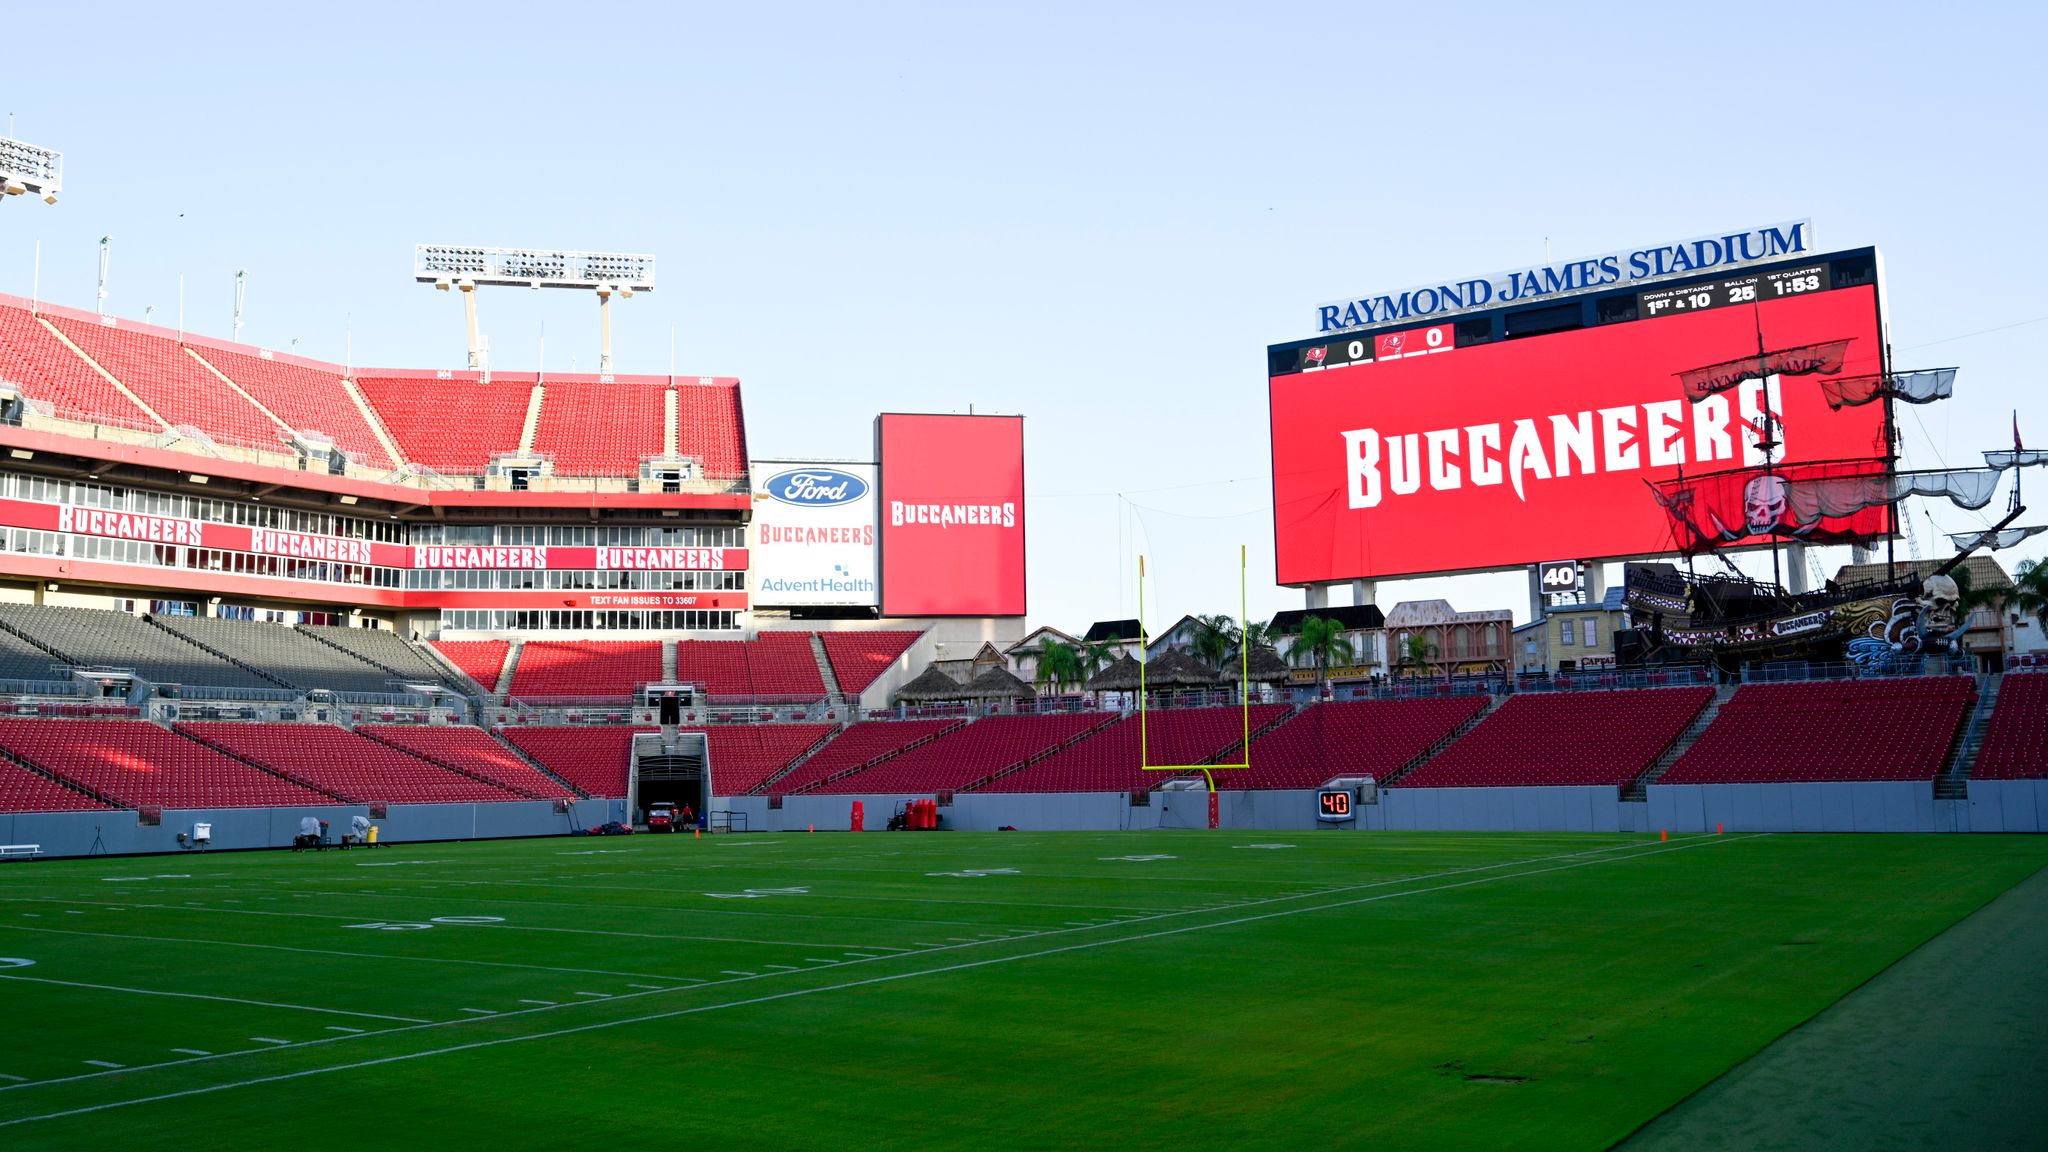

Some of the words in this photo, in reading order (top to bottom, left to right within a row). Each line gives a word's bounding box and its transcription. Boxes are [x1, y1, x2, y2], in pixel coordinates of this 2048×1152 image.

[1319, 278, 1493, 332] RAYMOND
[1498, 254, 1620, 301] JAMES
[1629, 222, 1807, 280] STADIUM
[1724, 280, 1745, 288] BALL
[1746, 277, 1758, 285] ON
[1783, 267, 1822, 279] QUARTER
[1643, 291, 1667, 301] DOWN
[1676, 284, 1715, 296] DISTANCE
[1729, 286, 1756, 303] 25
[1774, 275, 1820, 295] 1:53
[1647, 299, 1671, 315] 1ST
[1675, 300, 1686, 309] &
[1688, 293, 1711, 308] 10
[1426, 328, 1443, 347] 0
[1347, 341, 1364, 359] 0
[1340, 373, 1788, 510] BUCCANEERS
[784, 474, 849, 501] Ford
[58, 504, 202, 546] BUCCANEERS
[891, 501, 1015, 529] BUCCANEERS
[251, 527, 371, 564] BUCCANEERS
[760, 524, 873, 548] BUCCANEERS
[414, 546, 547, 569] BUCCANEERS
[595, 547, 724, 570] BUCCANEERS
[761, 577, 874, 592] AdventHealth
[1543, 566, 1575, 586] 40
[590, 596, 612, 605] TEXT
[613, 596, 629, 605] FAN
[631, 596, 661, 605] ISSUES
[662, 595, 674, 605] TO
[675, 595, 697, 605] 33607
[1776, 612, 1824, 634] BUCCANEERS
[1323, 794, 1347, 813] 40
